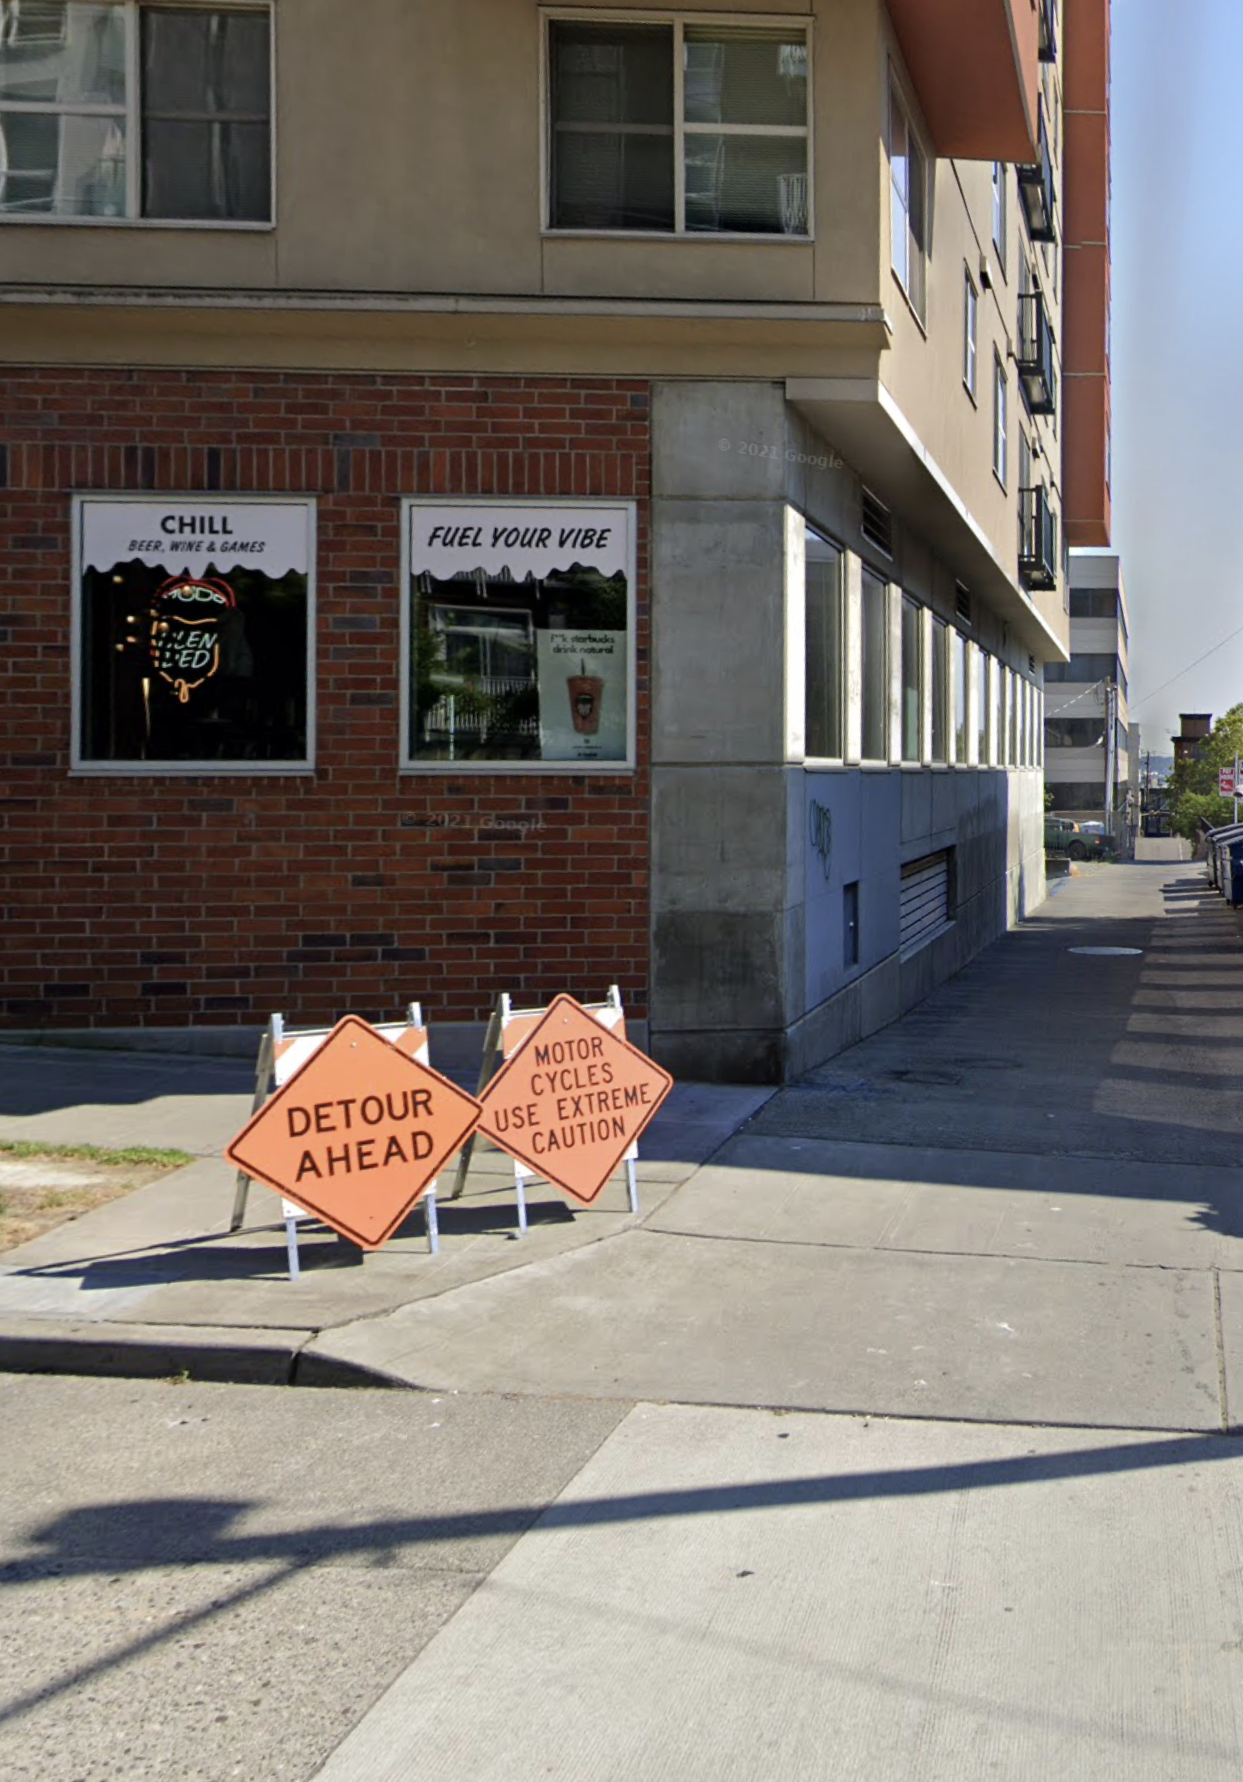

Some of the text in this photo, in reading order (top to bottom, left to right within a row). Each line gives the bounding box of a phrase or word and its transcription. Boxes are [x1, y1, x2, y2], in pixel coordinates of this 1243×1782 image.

[160, 515, 234, 535] CHILL
[427, 526, 612, 549] FUEL YOUR VIBE
[128, 540, 266, 553] BEER, WINE & GAMES
[553, 645, 614, 654] drink natural
[571, 633, 616, 644] starbucks
[534, 1036, 604, 1067] MOTOR
[530, 1062, 614, 1096] CYCLES
[287, 1088, 434, 1138] DETOUR
[494, 1083, 651, 1132] USE EXTREME
[531, 1115, 626, 1154] CAUTION
[294, 1130, 434, 1183] AHEAD
